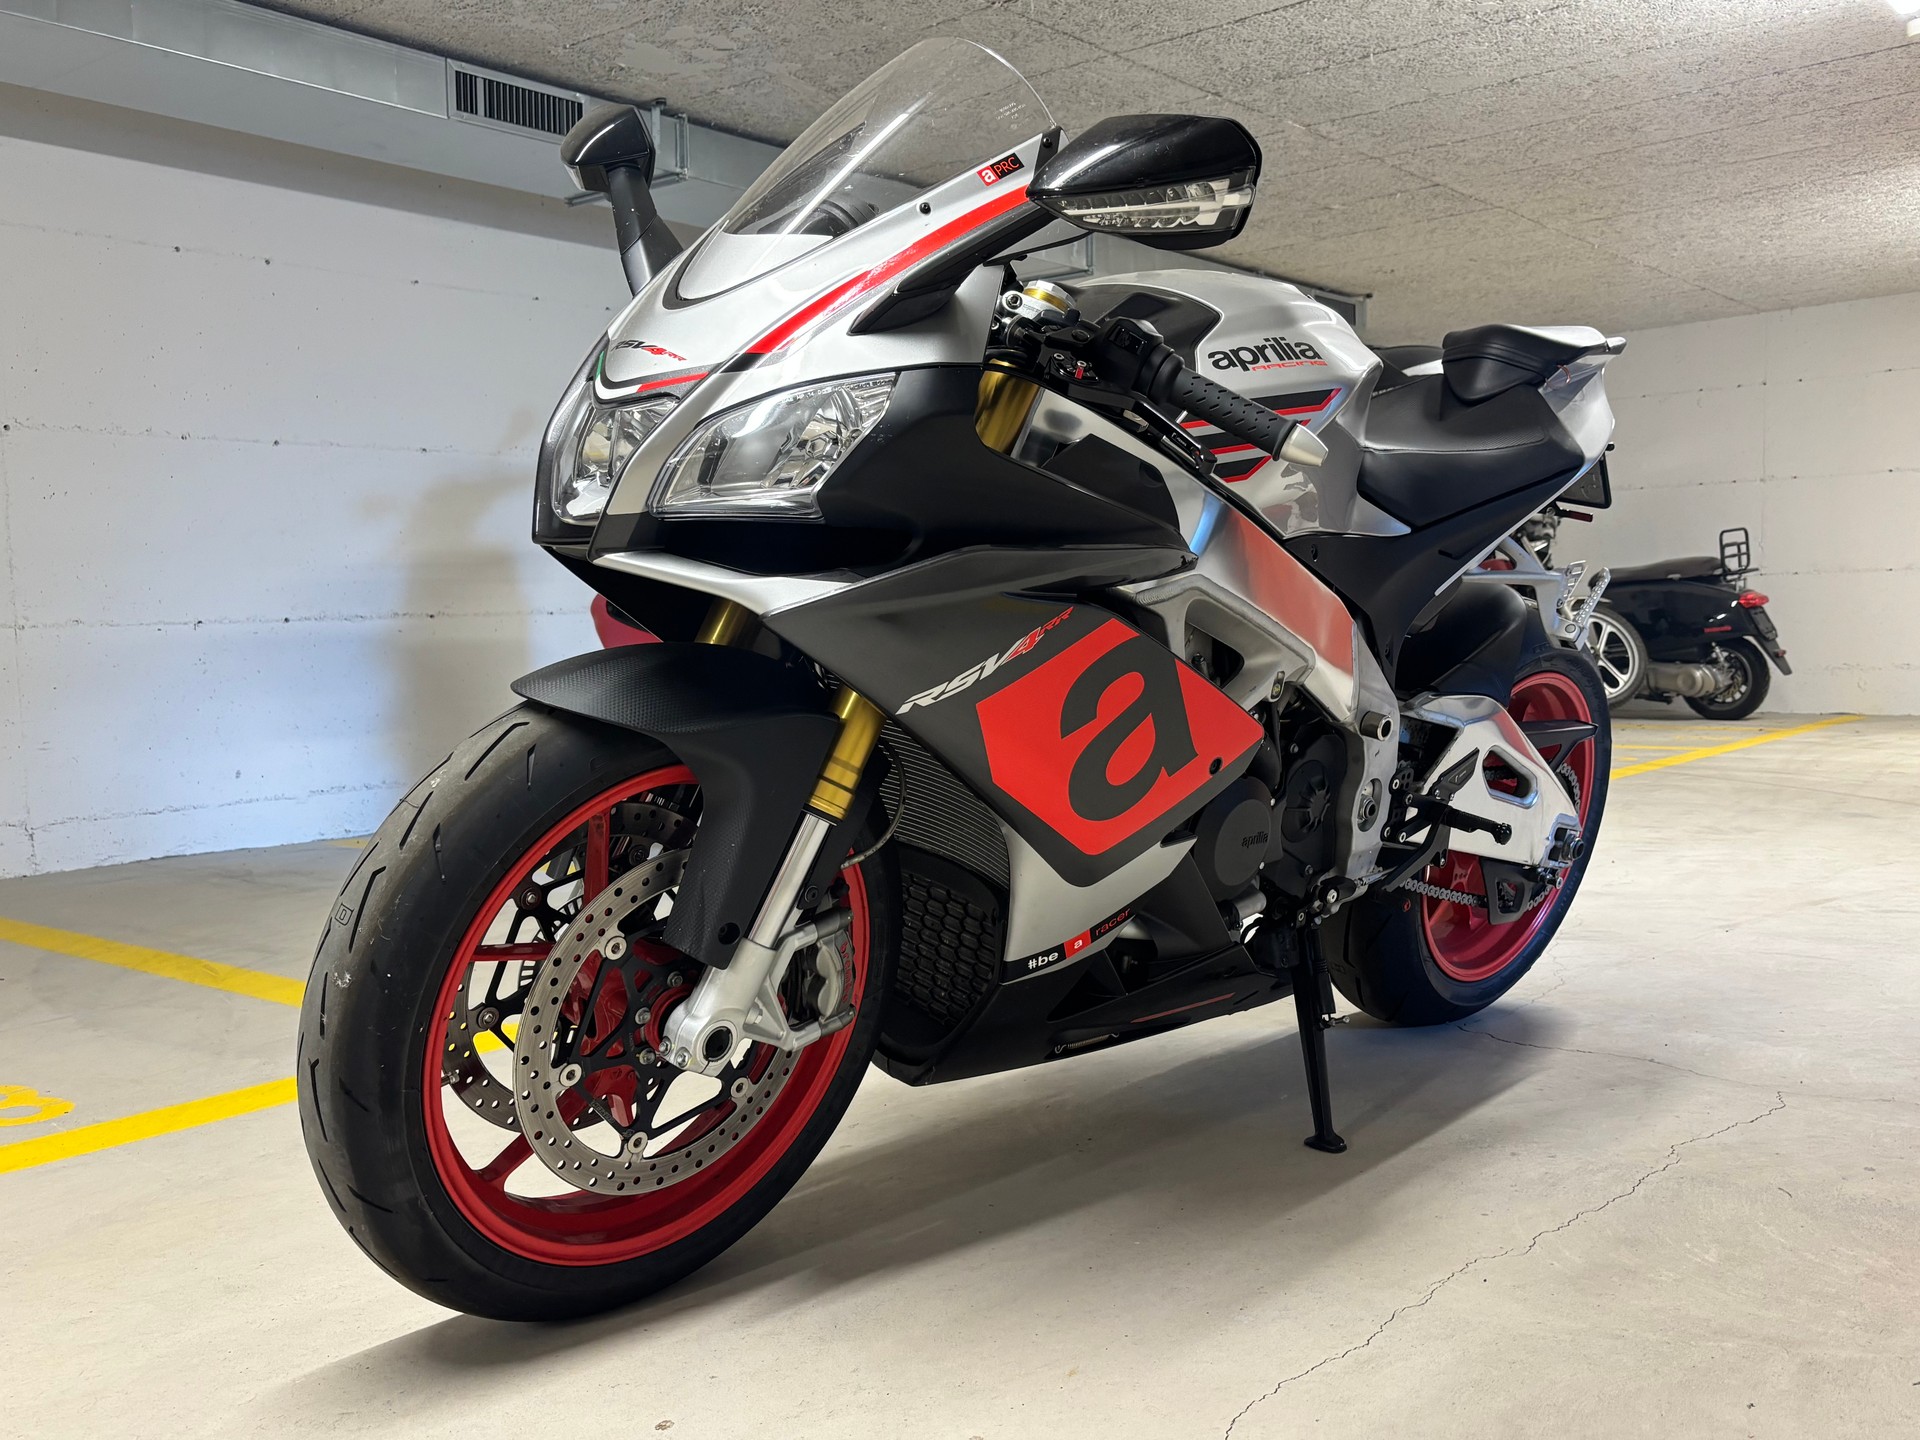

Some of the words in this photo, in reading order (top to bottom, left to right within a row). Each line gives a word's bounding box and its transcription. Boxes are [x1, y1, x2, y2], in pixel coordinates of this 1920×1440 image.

[1207, 336, 1323, 372] aprilia
[1251, 360, 1328, 372] RACING
[1241, 831, 1269, 849] aprilia
[1027, 952, 1059, 970] #be
[1073, 939, 1083, 950] a
[1094, 908, 1131, 936] racer
[840, 940, 852, 1004] brembo
